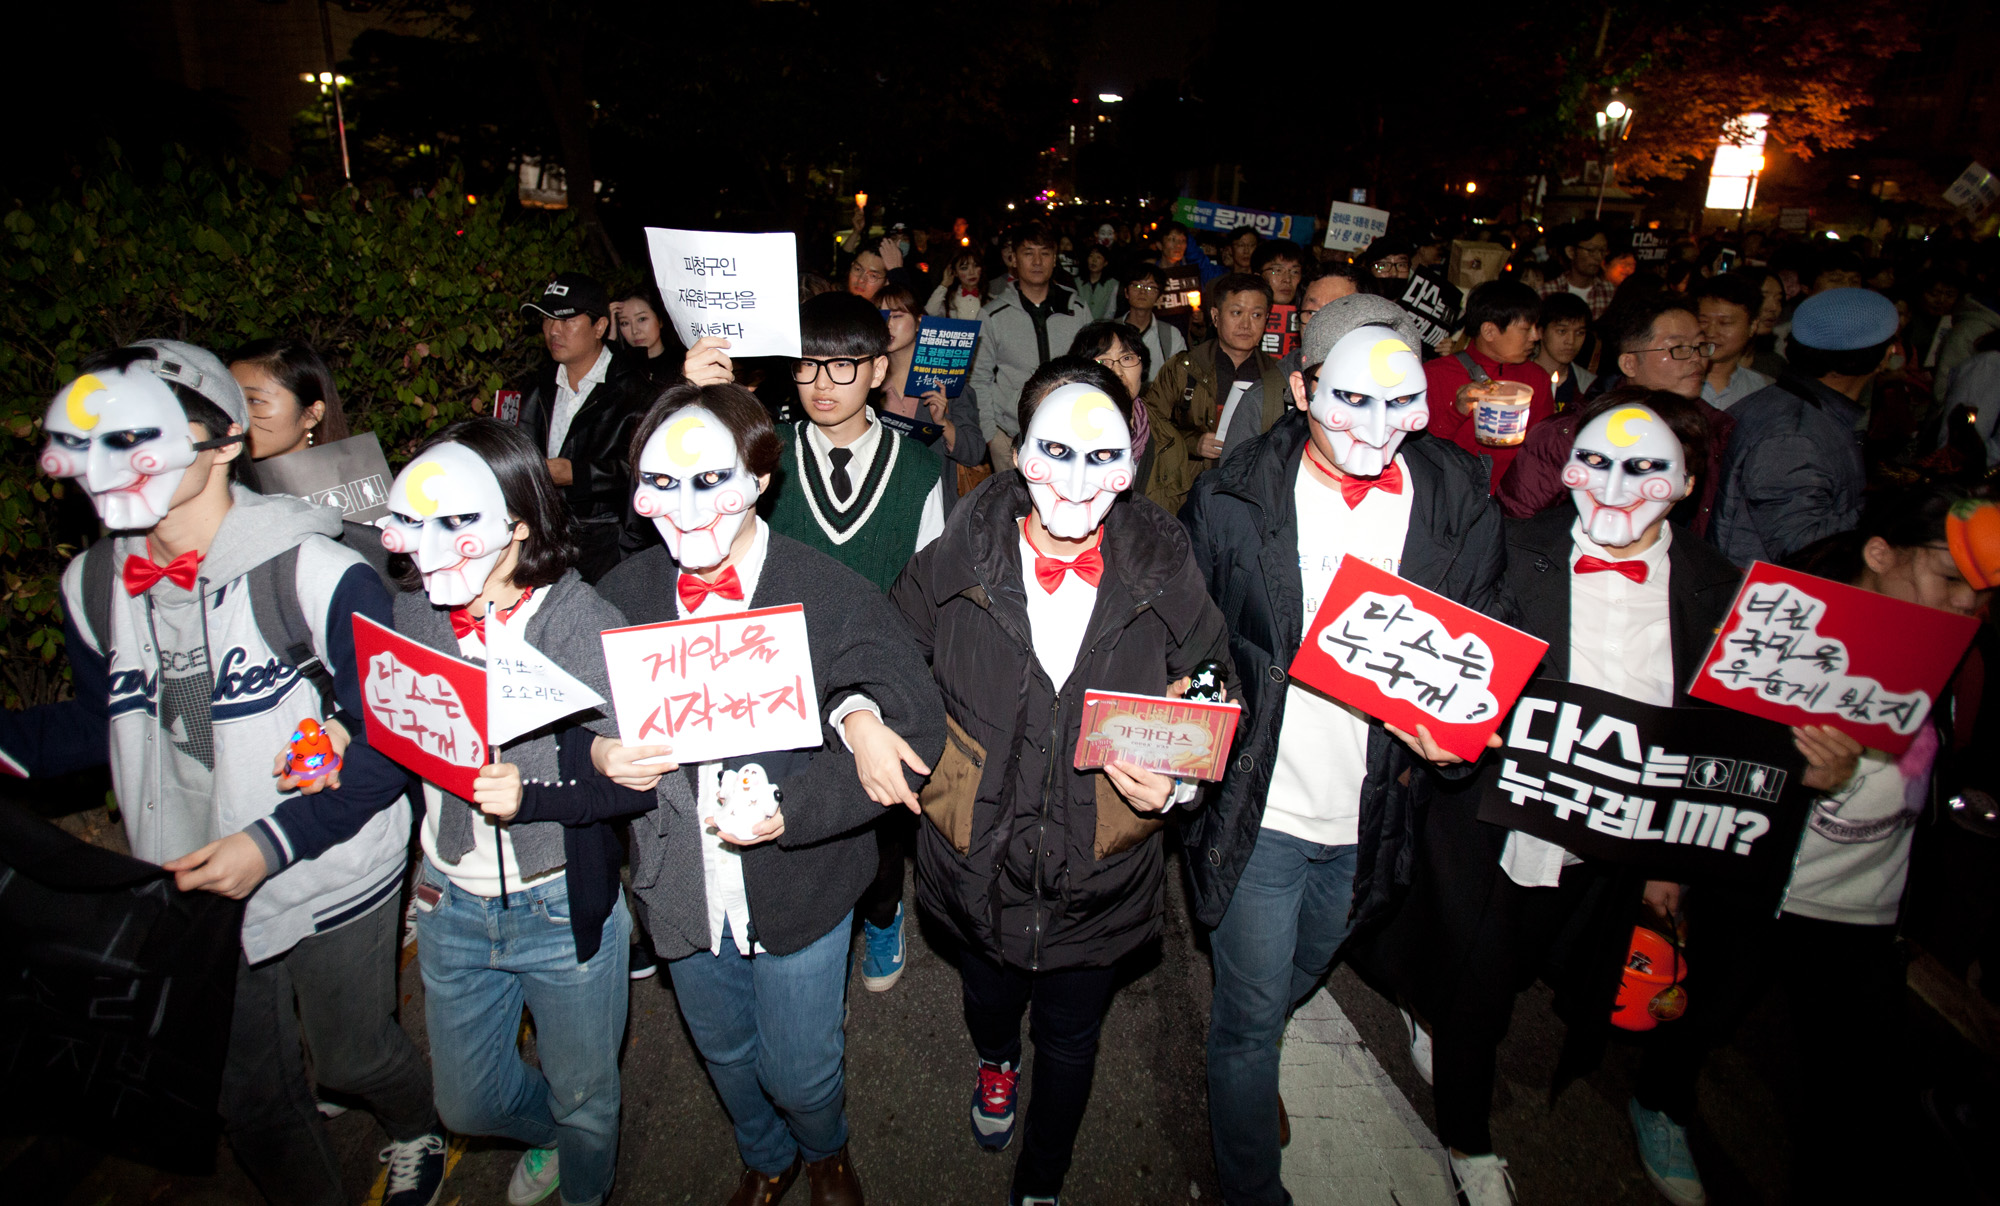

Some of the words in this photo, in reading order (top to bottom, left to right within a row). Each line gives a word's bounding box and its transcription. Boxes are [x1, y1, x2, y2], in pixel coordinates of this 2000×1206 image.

[1213, 207, 1277, 236] 문재인
[1277, 214, 1293, 240] 1
[683, 256, 737, 276] 피청구인
[678, 288, 757, 310] 자유한국당을
[1402, 274, 1446, 319] 다스는
[641, 623, 780, 682] 게임을
[1730, 627, 1843, 674] 국민을
[501, 684, 565, 702] 오소리단
[638, 674, 807, 740] 시작하지
[1714, 658, 1830, 708] 우습게
[1835, 685, 1922, 730] 봤지
[1113, 724, 1193, 746] 가카다스
[1507, 696, 1690, 788] 다스는
[1498, 758, 1770, 855] 누구겁니까?
